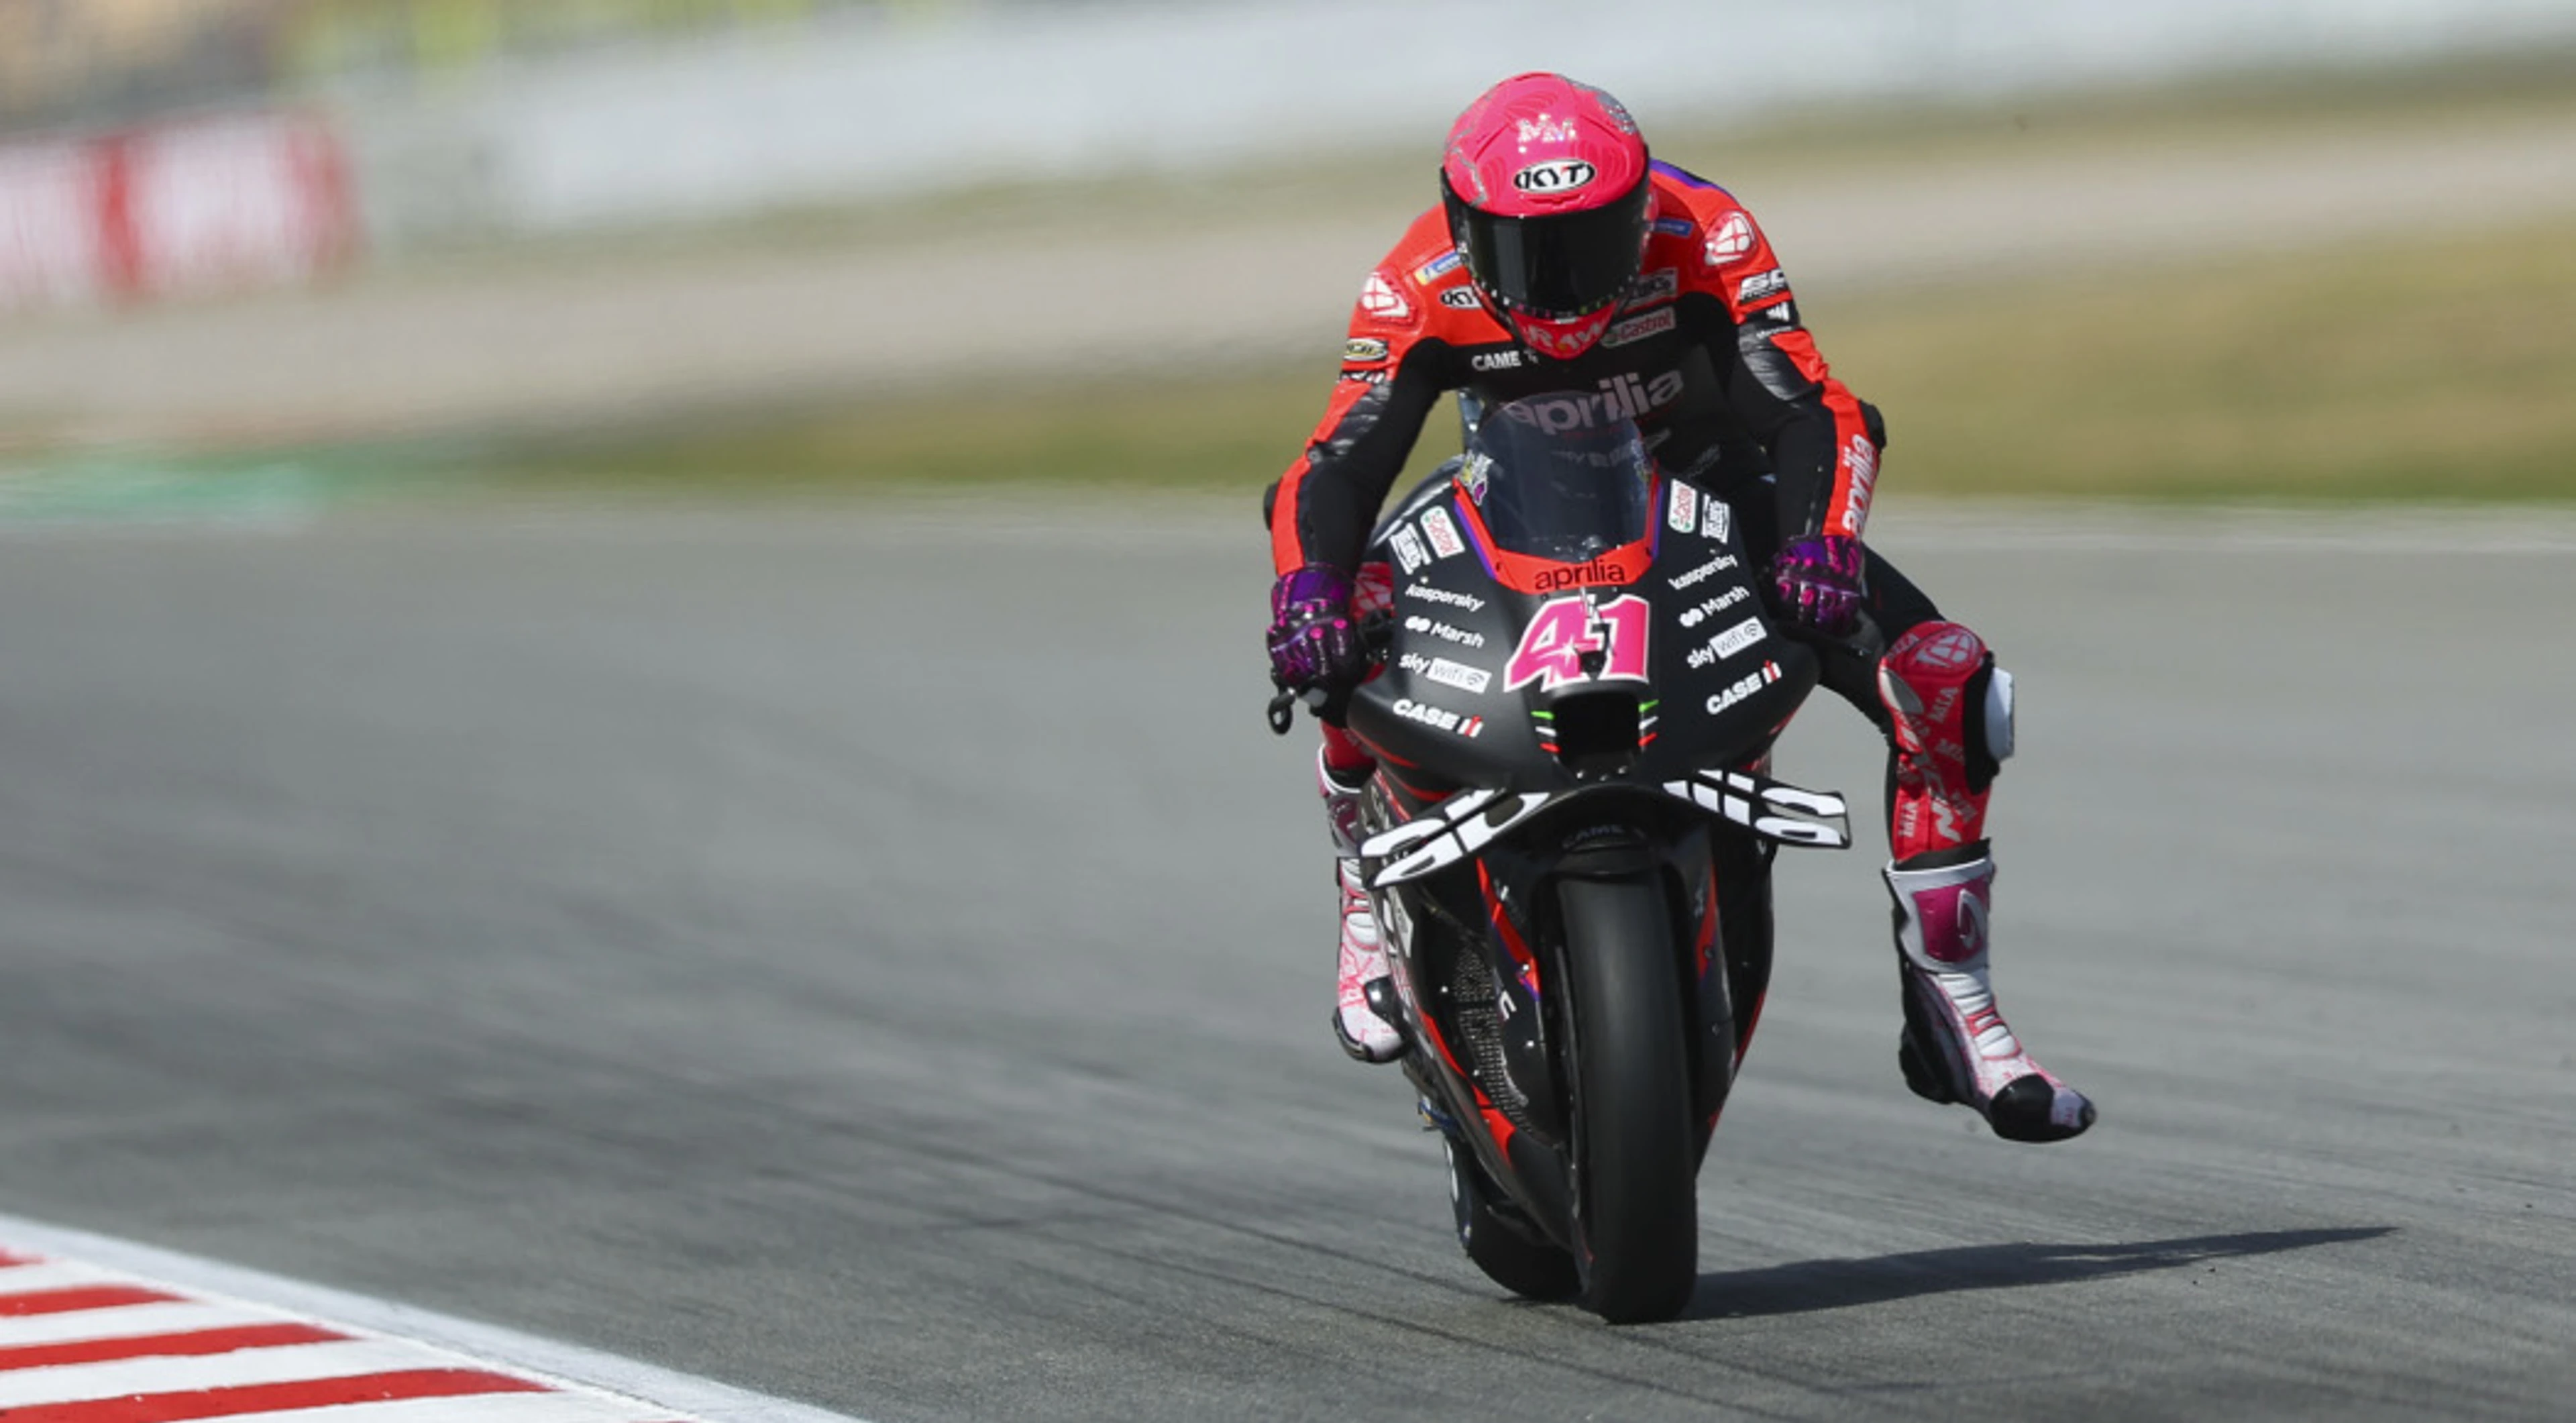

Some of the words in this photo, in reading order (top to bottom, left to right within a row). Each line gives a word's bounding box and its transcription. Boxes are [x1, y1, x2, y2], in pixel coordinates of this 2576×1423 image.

[1525, 163, 1585, 189] KYT
[1619, 313, 1670, 339] Castrol
[1472, 351, 1521, 370] CAME
[1501, 370, 1684, 435] aprilia
[1534, 560, 1626, 590] aprilia
[1668, 554, 1738, 590] kaspersky
[1405, 584, 1485, 613] kaspersky
[1700, 585, 1750, 617] Marsh
[1430, 622, 1485, 649] Marsh
[1503, 594, 1650, 693] 41
[1399, 652, 1430, 674] sky
[1686, 645, 1716, 670] sky
[1706, 672, 1763, 715] CASE
[1393, 699, 1461, 731] CASE
